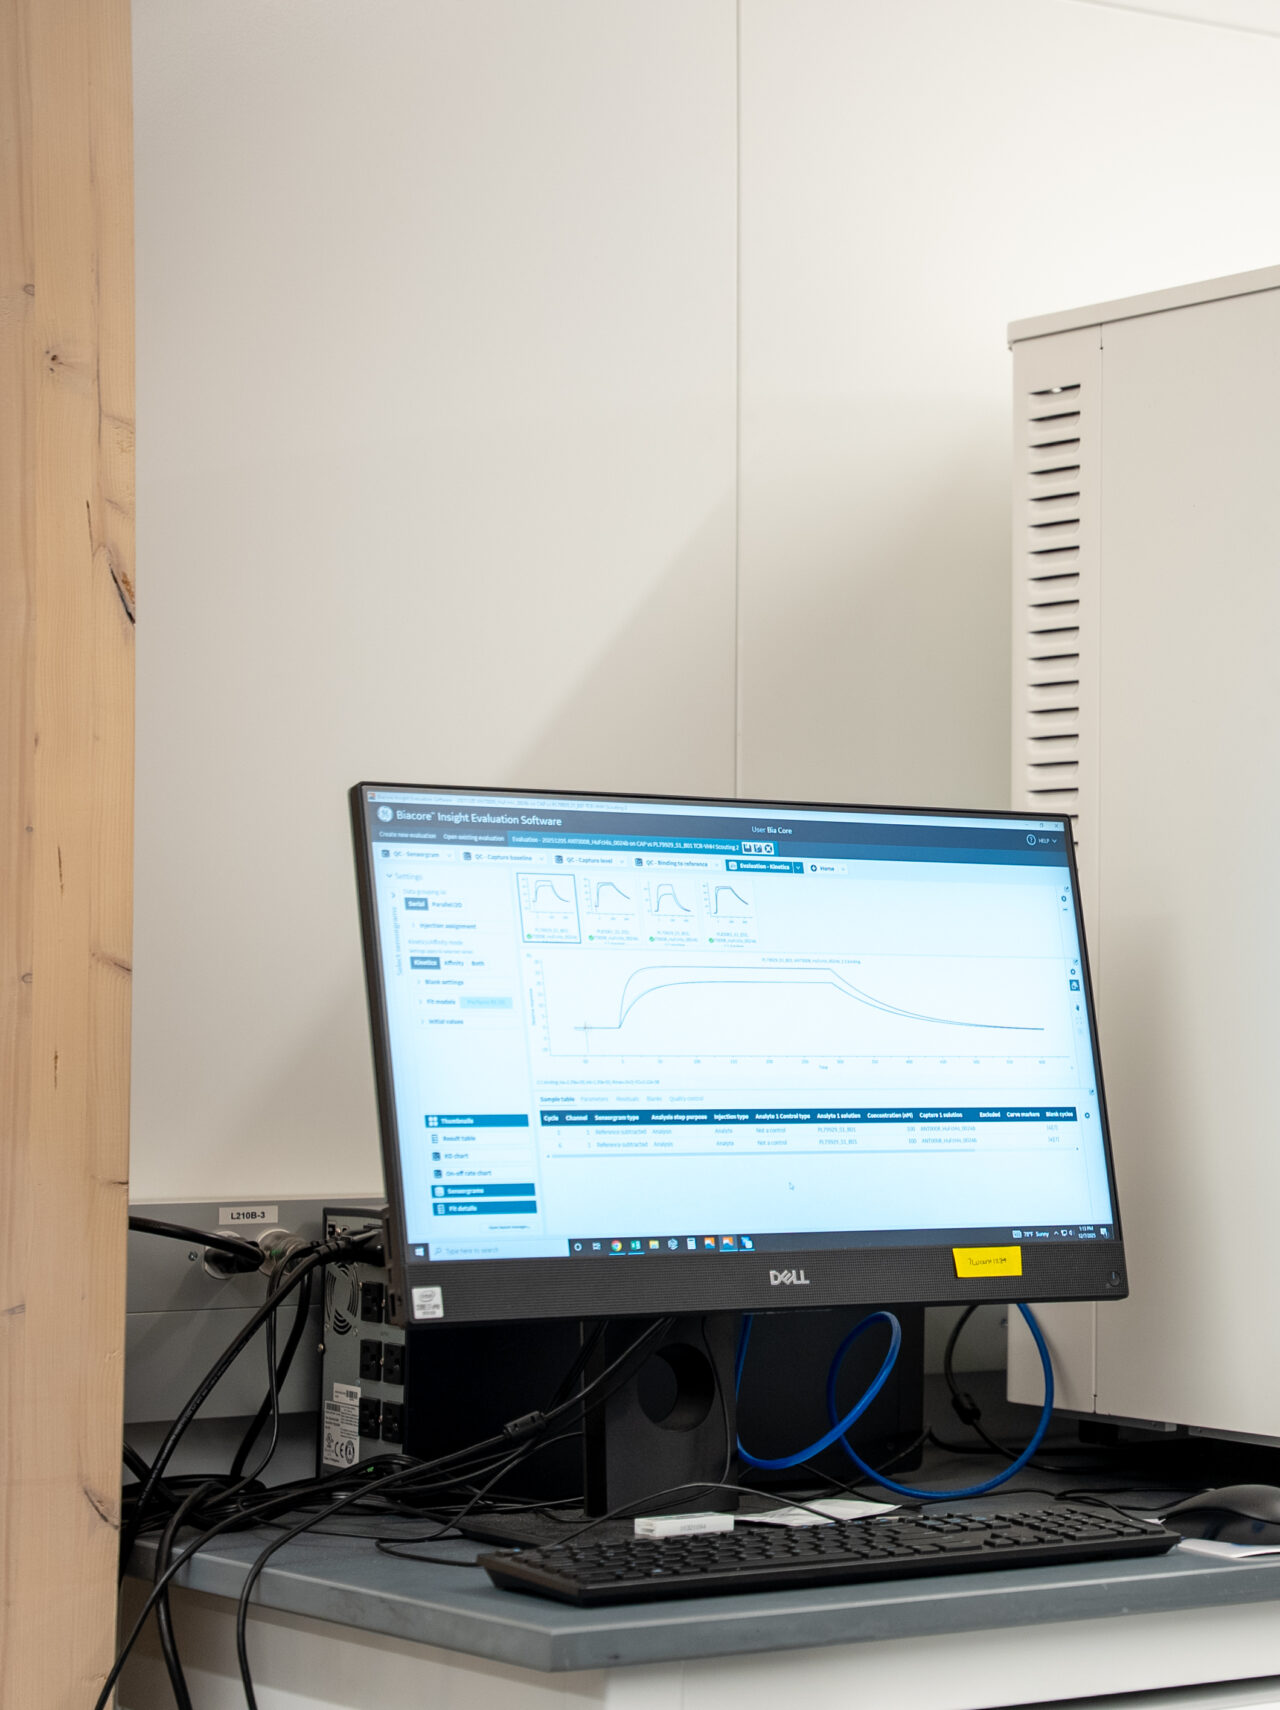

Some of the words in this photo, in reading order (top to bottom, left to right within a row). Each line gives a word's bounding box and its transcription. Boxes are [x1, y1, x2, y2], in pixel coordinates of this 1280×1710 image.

[437, 812, 471, 824] Insight
[472, 814, 519, 825] Evaluation
[520, 815, 563, 827] Software
[778, 827, 794, 835] Core
[230, 1211, 266, 1220] L210B-3
[769, 1270, 811, 1286] DELL
